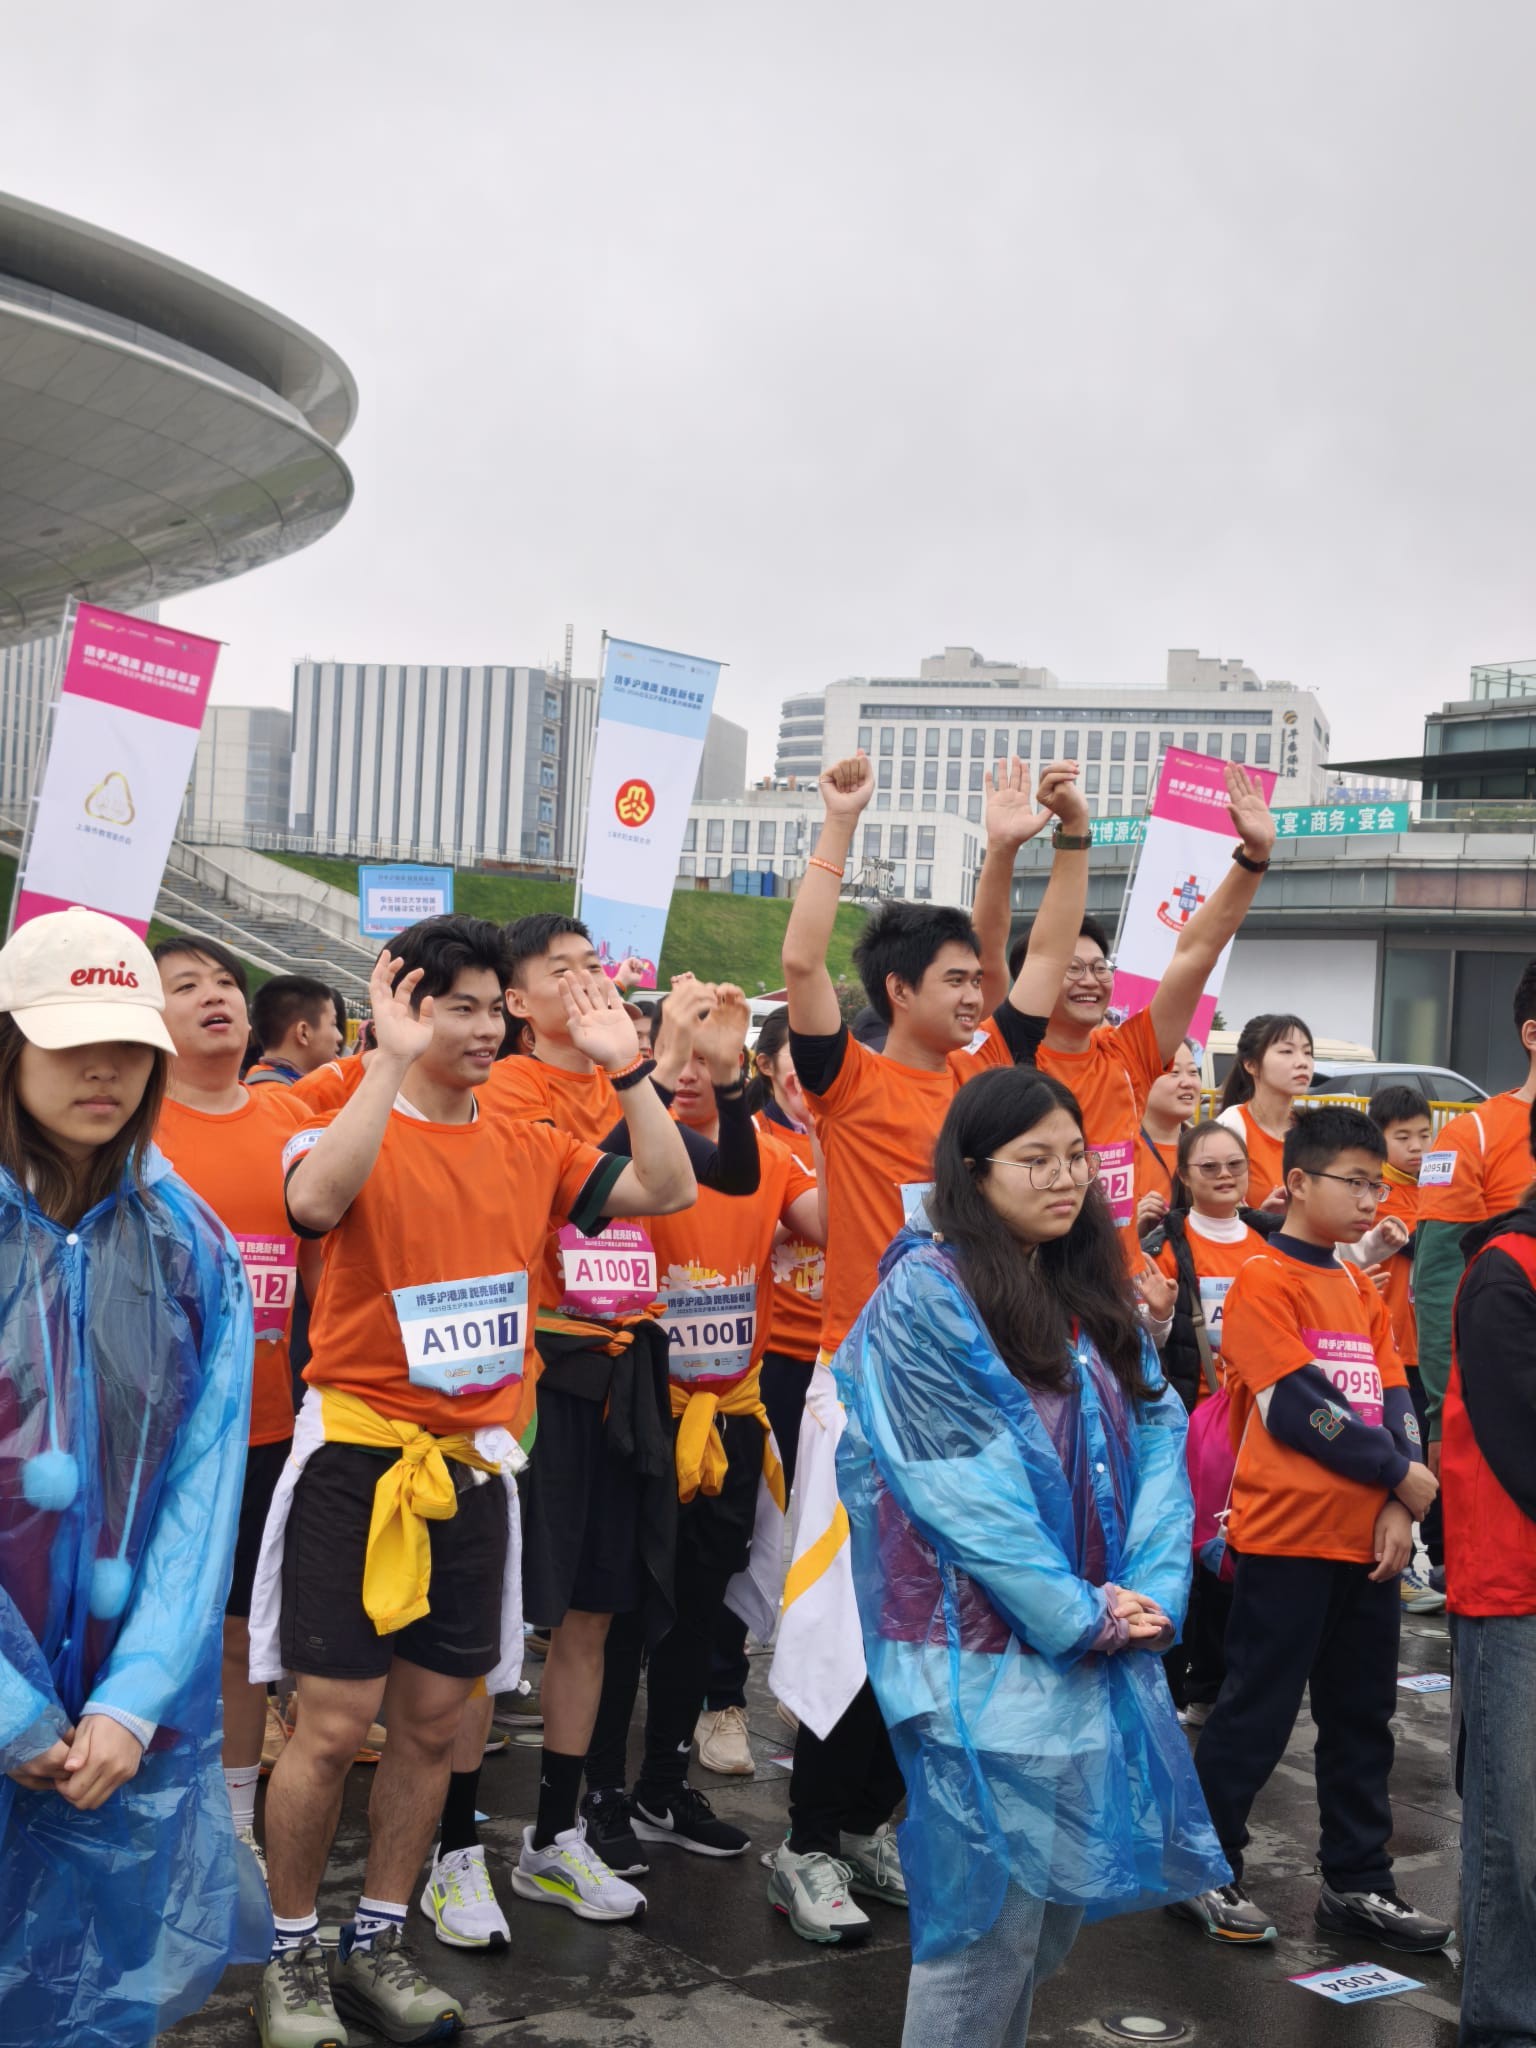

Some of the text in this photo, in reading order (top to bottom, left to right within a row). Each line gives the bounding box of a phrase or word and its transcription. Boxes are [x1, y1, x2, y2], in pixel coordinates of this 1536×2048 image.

[71, 961, 139, 988] emis
[576, 1258, 649, 1288] A1002
[416, 1282, 515, 1307] 携手沪港澳 跑亮新希望
[422, 1311, 518, 1356] A1011
[668, 1316, 753, 1347] A1001
[1320, 1971, 1388, 1992] A094
